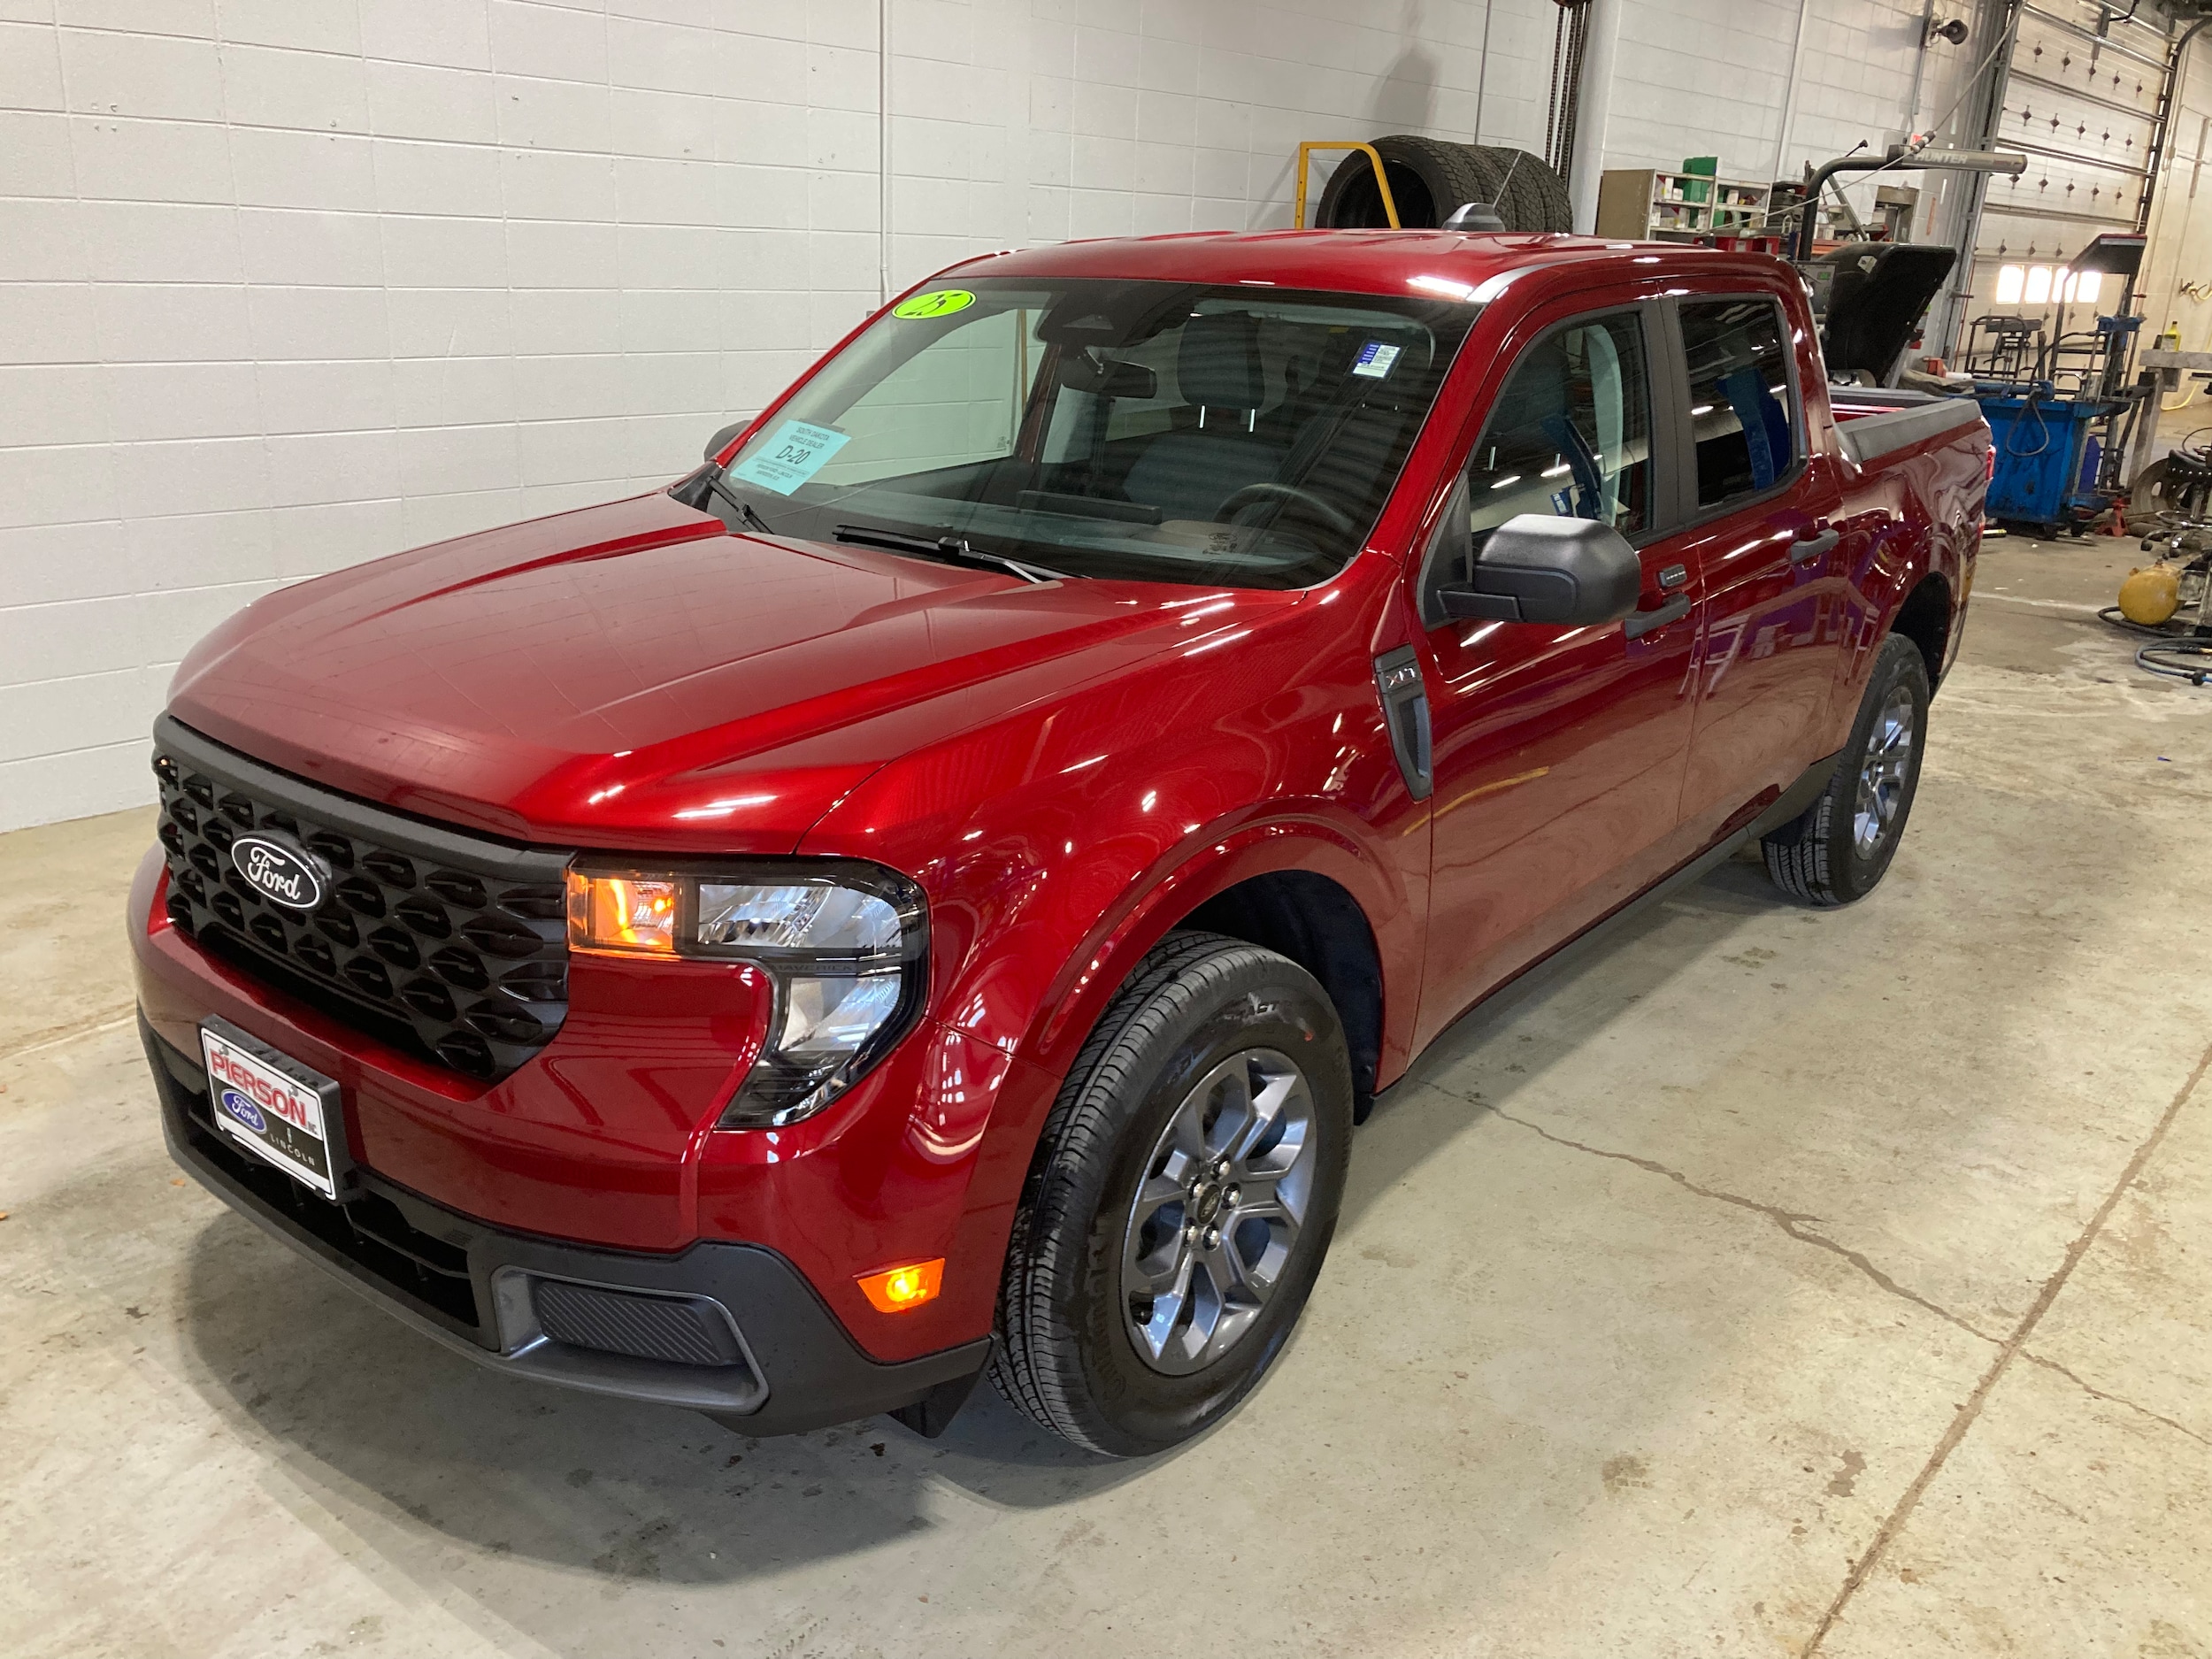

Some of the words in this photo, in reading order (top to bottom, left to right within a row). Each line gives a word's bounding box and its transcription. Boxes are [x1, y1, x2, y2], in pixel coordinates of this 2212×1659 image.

[1914, 150, 1969, 165] HUNTER
[775, 445, 811, 465] D-20
[248, 846, 301, 900] Ford
[210, 1048, 307, 1128] PIERSON
[232, 1094, 259, 1126] Ford
[270, 1133, 315, 1166] LINCOLN
